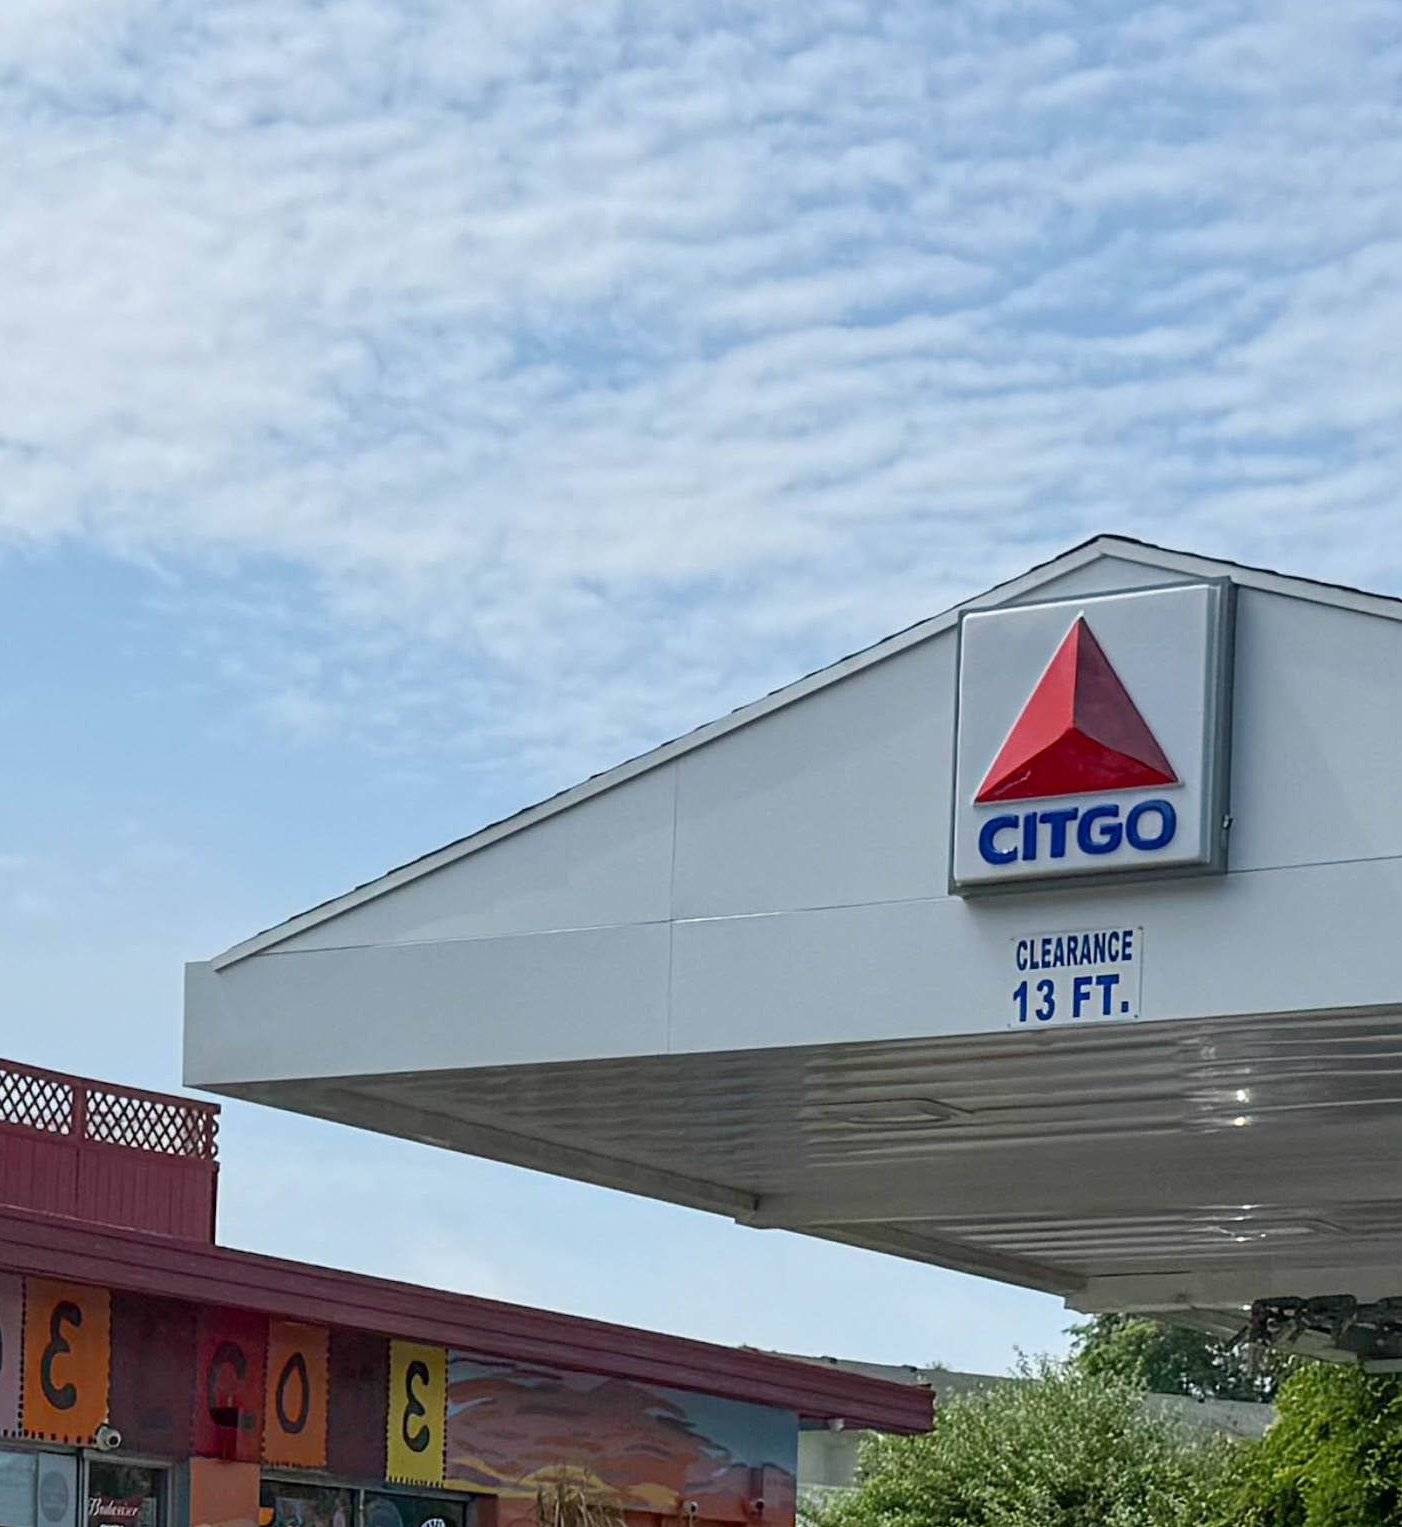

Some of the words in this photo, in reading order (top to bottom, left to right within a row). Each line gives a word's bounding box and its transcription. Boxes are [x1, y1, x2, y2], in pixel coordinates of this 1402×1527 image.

[978, 799, 1177, 865] CITGO
[1015, 929, 1134, 972] CLEARANCE
[1013, 979, 1056, 1023] 13
[1071, 973, 1130, 1019] FT.
